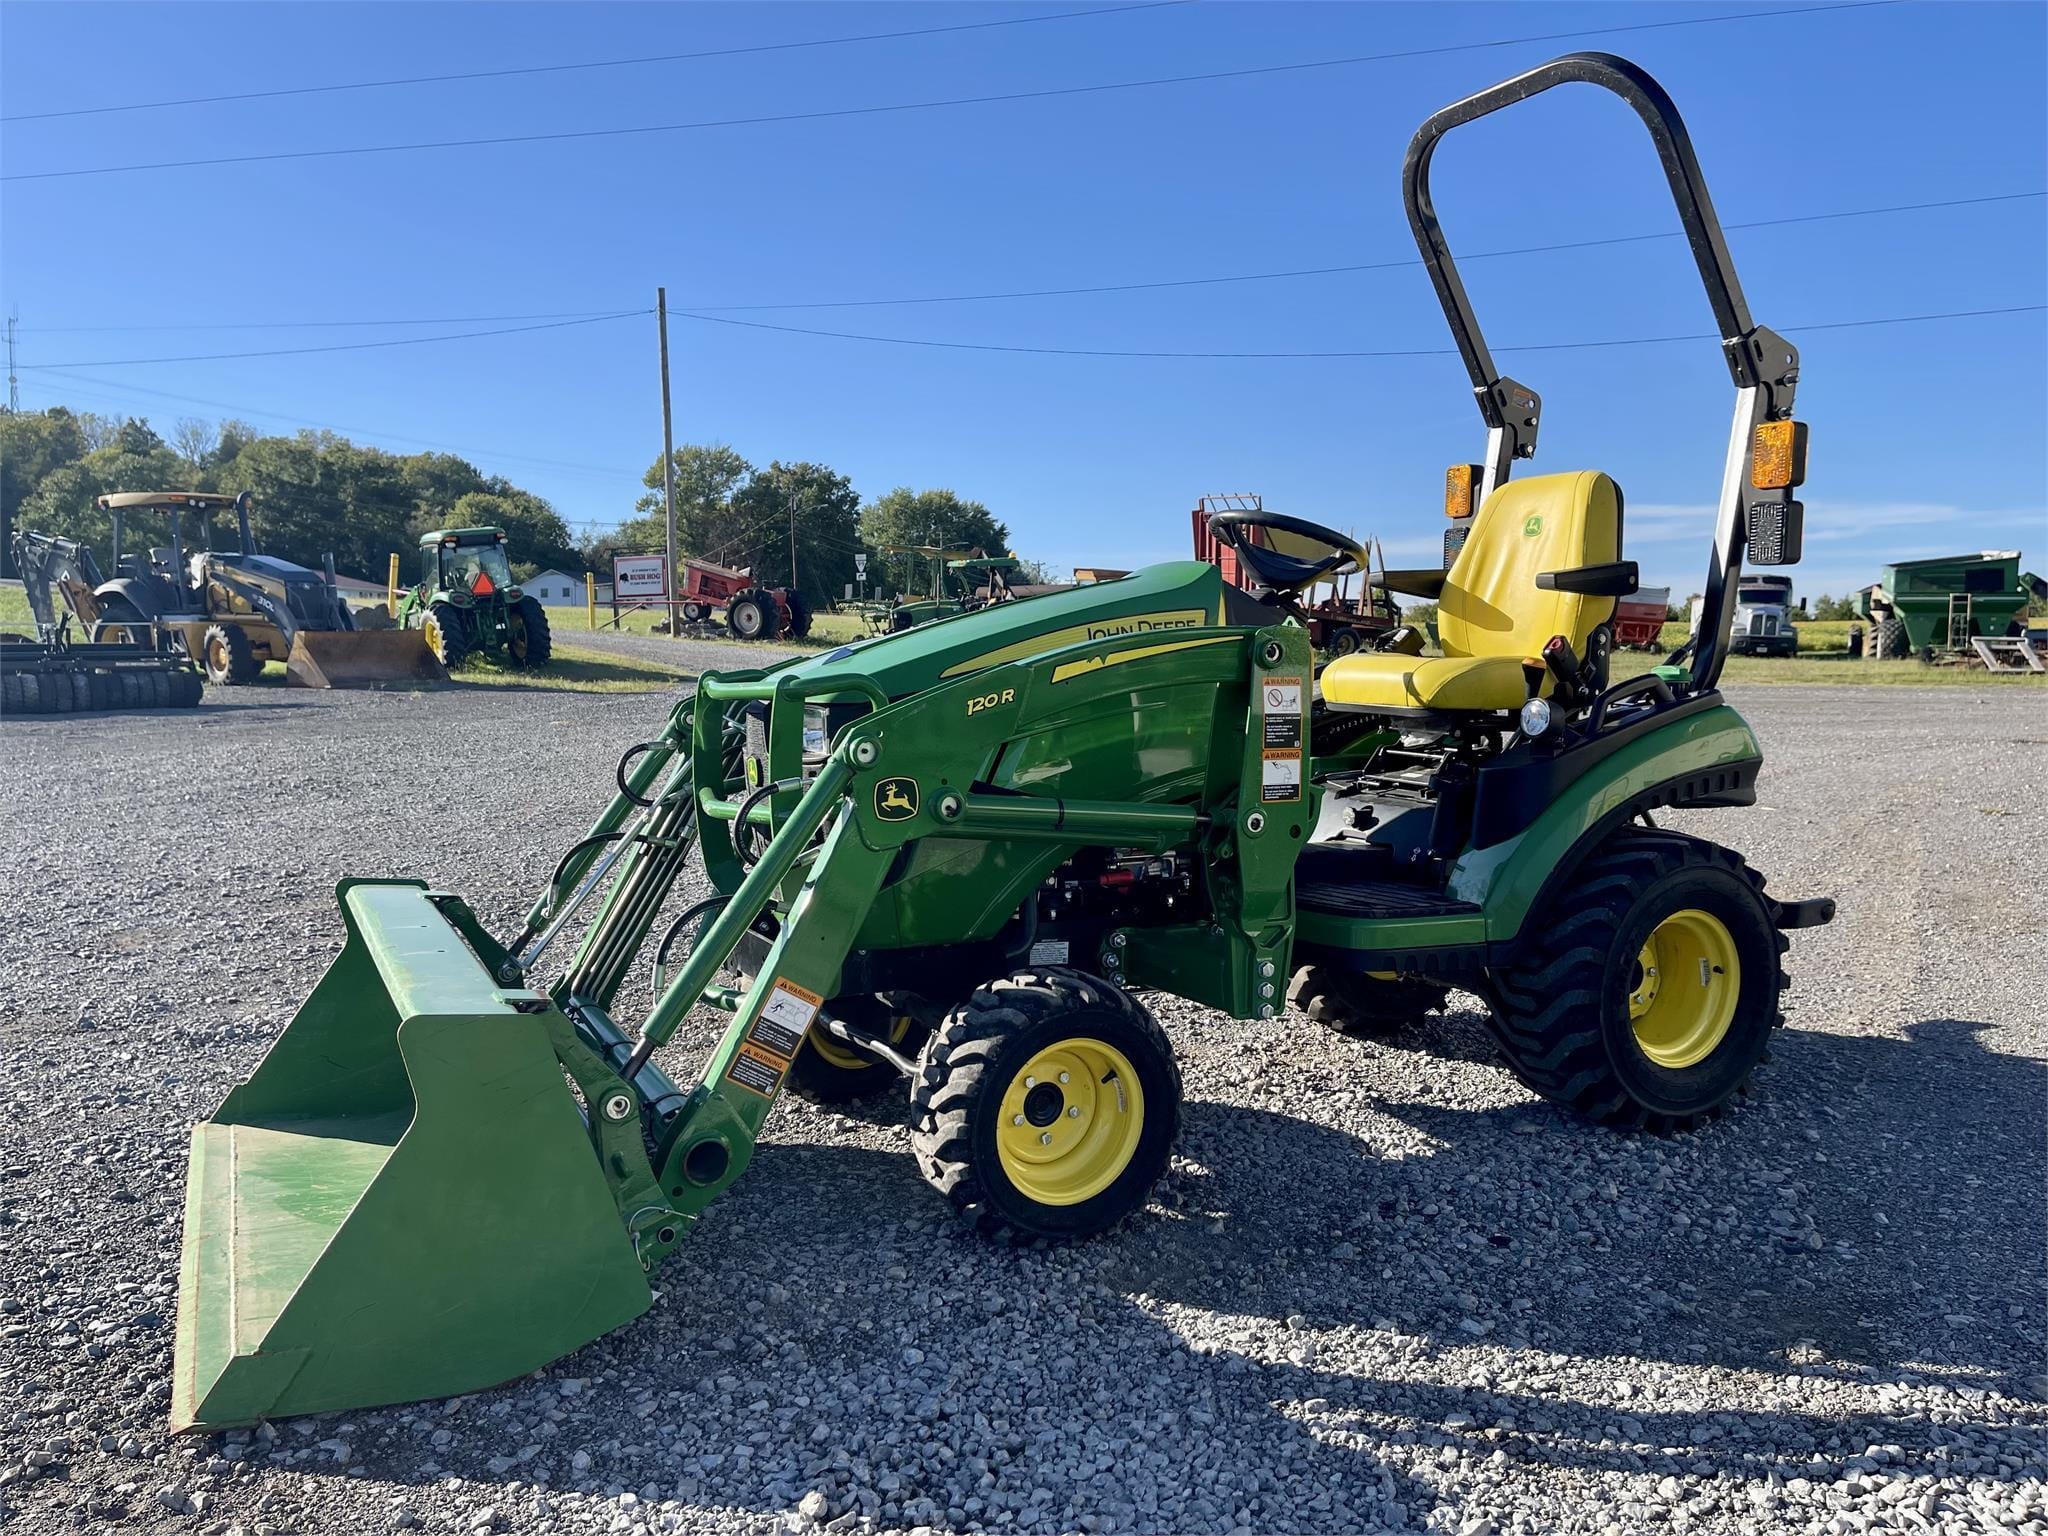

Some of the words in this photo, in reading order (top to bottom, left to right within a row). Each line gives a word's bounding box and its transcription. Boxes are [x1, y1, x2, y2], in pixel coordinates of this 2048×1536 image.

[647, 572, 661, 580] HOG
[1087, 625, 1133, 640] JOHN
[1270, 751, 1300, 759] WARNING
[788, 985, 817, 1003] WARNING
[753, 1050, 783, 1069] WARNING
